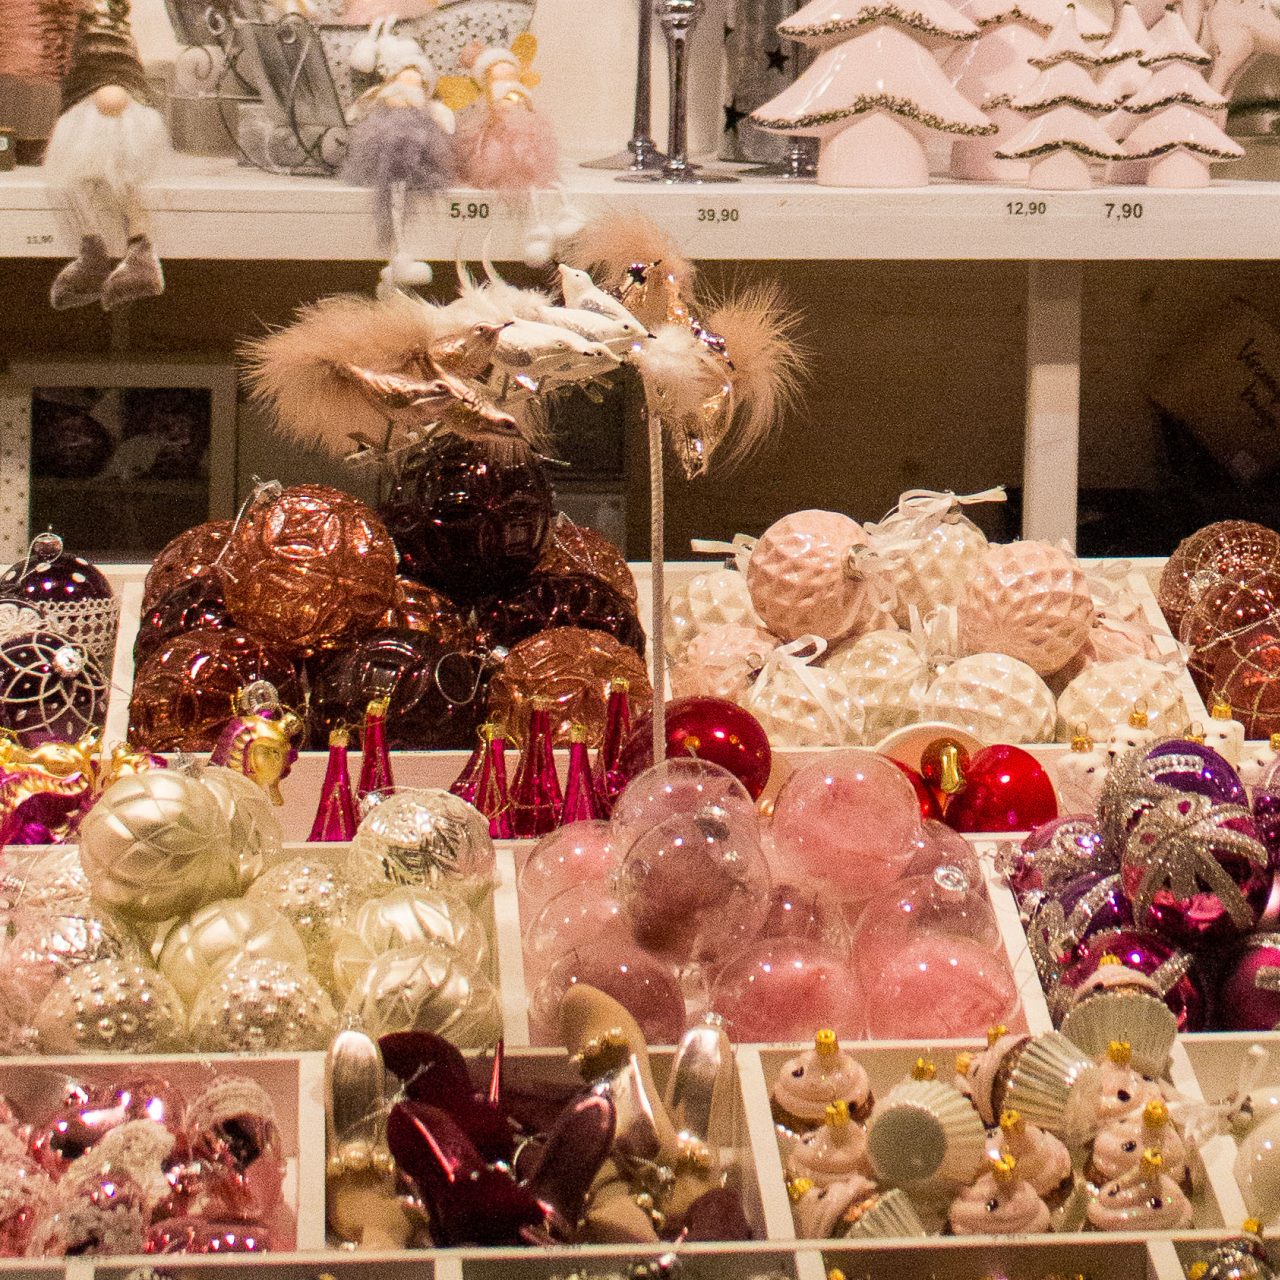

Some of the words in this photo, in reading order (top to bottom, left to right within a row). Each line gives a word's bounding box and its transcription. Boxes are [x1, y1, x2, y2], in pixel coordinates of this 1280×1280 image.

[450, 202, 490, 220] 5,90
[697, 208, 740, 223] 39,90
[1006, 201, 1047, 216] 12,90
[1104, 203, 1143, 220] 7,90
